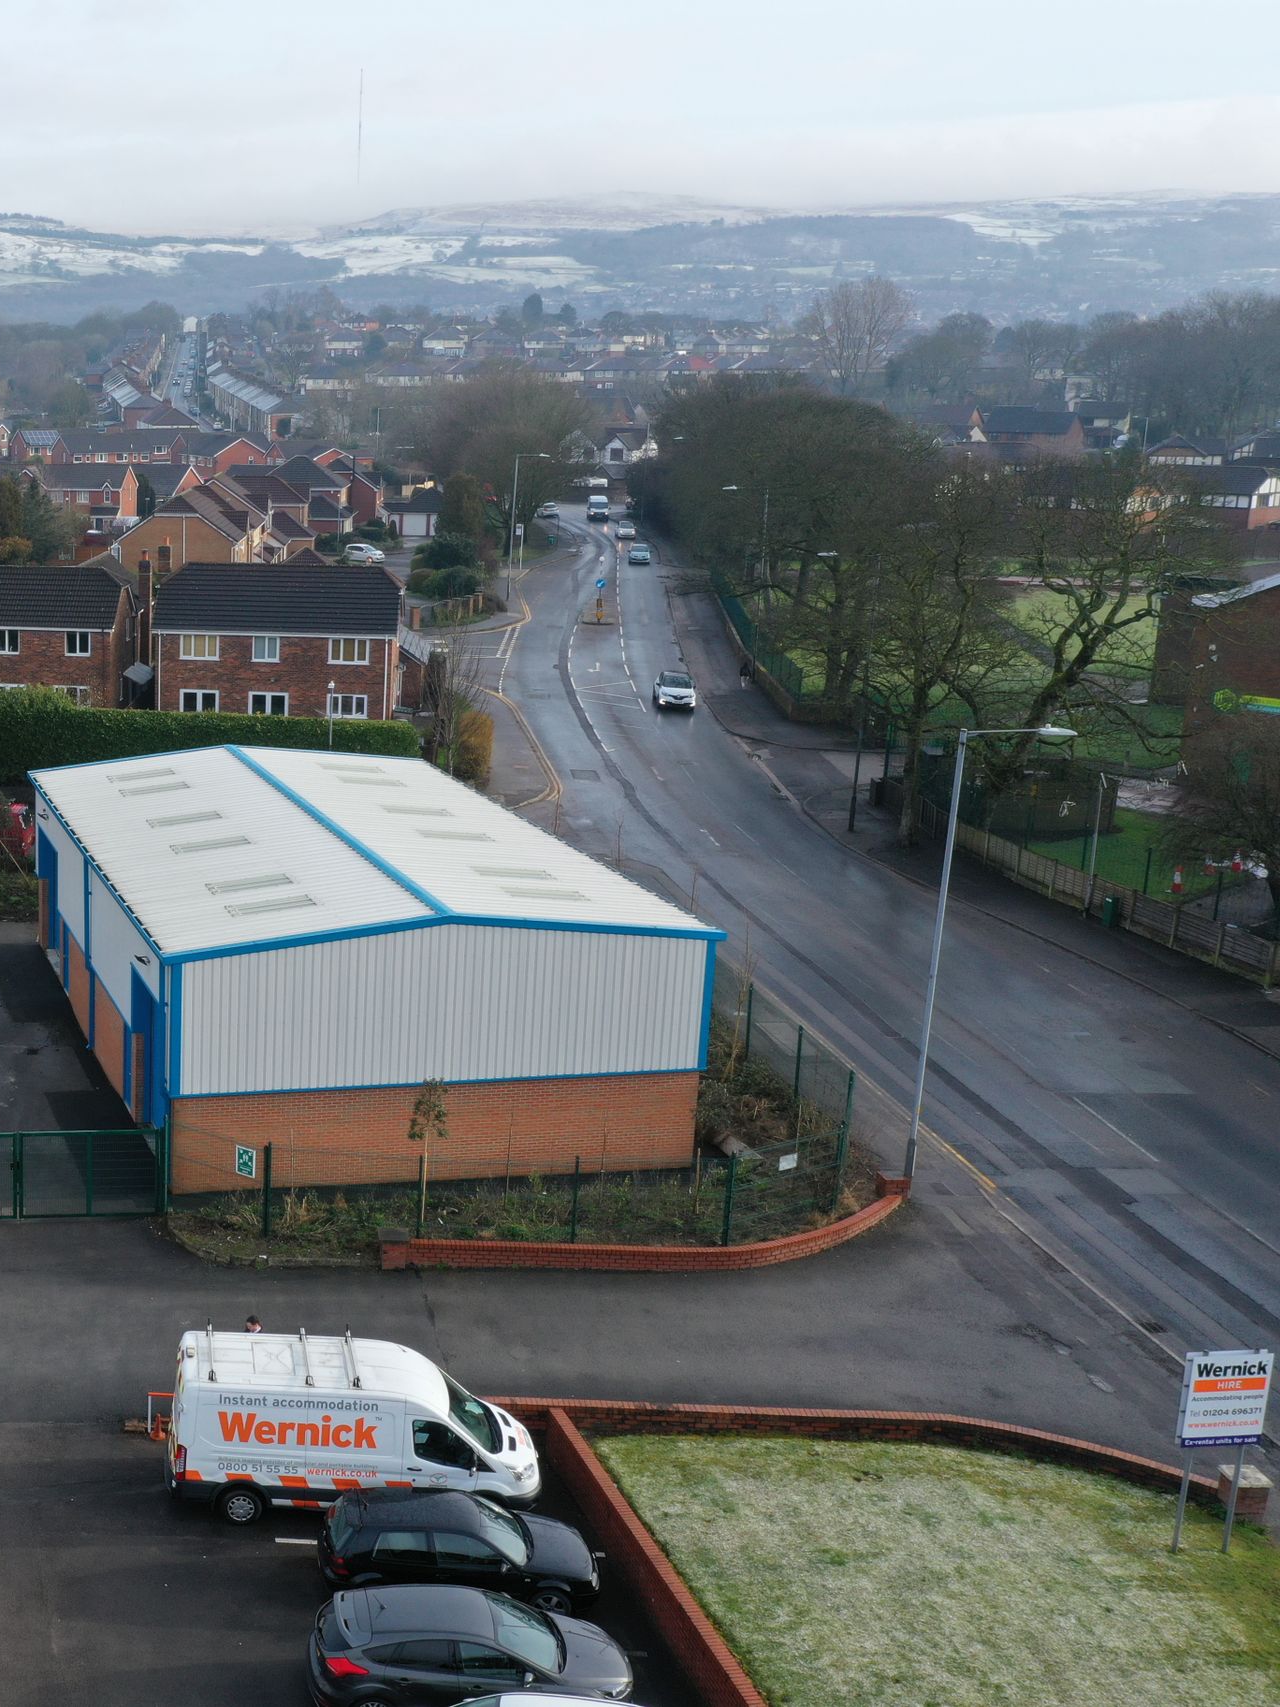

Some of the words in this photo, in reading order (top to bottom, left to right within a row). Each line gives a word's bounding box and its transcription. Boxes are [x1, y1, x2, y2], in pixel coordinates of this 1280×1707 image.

[1197, 1361, 1268, 1378] Wernick
[1217, 1381, 1242, 1389] HIRE
[220, 1394, 267, 1407] Instant
[272, 1399, 379, 1412] accommodation
[1231, 1407, 1262, 1415] 696371
[1187, 1419, 1260, 1428] www.wernick.co.uk
[218, 1411, 378, 1449] Wernick
[1184, 1438, 1215, 1446] Ex-rental
[217, 1462, 248, 1472] 0800
[251, 1464, 263, 1472] 51
[266, 1465, 281, 1474] 55
[284, 1466, 298, 1475] 55
[307, 1468, 377, 1478] wernick.co.uk
